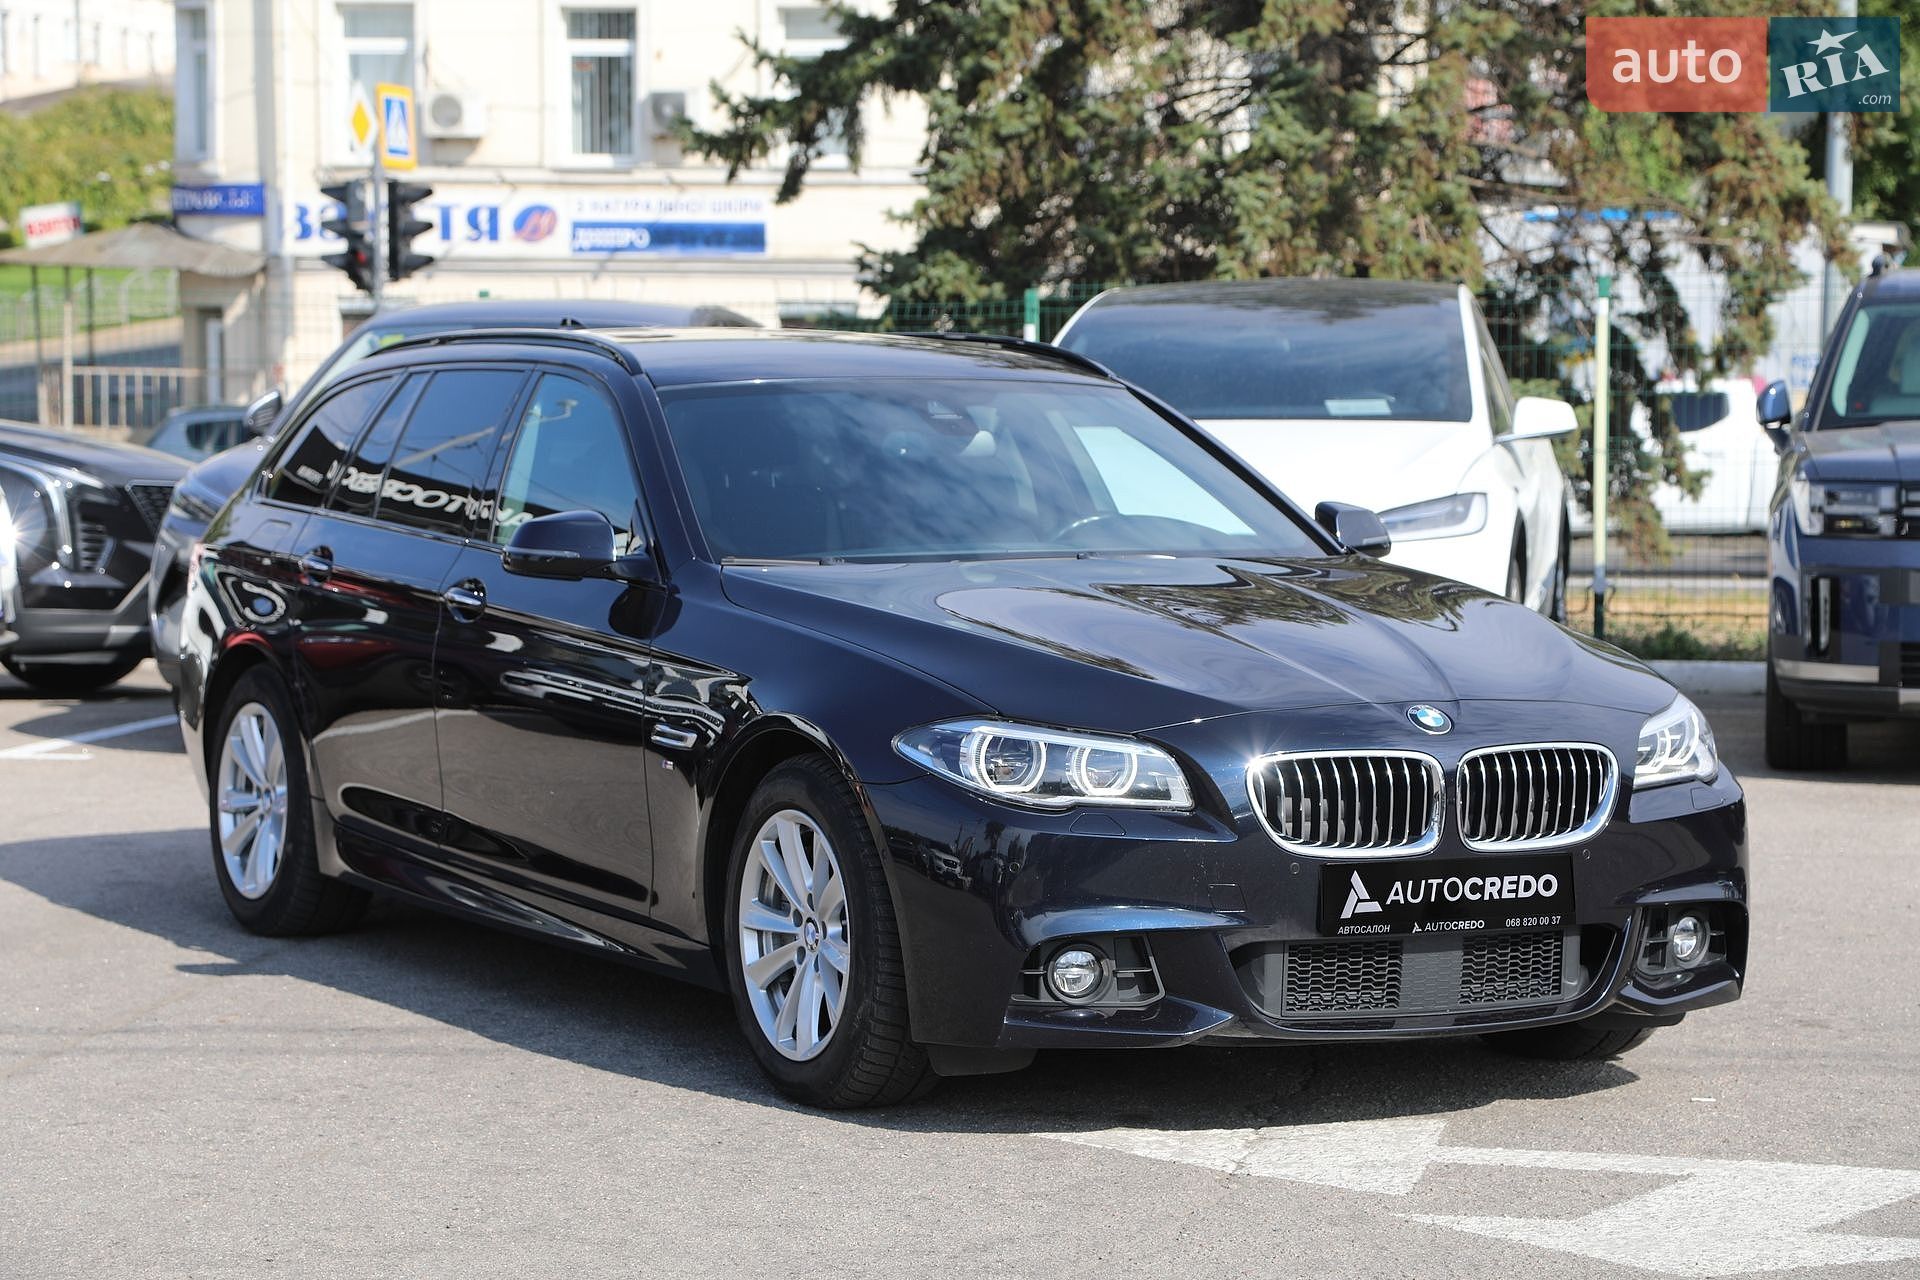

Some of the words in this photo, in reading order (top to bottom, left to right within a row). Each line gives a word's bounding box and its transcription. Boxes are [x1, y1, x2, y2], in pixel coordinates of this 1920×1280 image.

[294, 203, 500, 241] ВЗТЯ
[1386, 873, 1558, 905] AUTOCREDO
[1424, 919, 1485, 932] AUTOCREDO
[1505, 918, 1521, 928] 068
[1522, 917, 1537, 927] 820
[1538, 916, 1550, 926] 00
[1551, 915, 1561, 925] 37
[1337, 924, 1391, 935] АВТОСАЛОН
